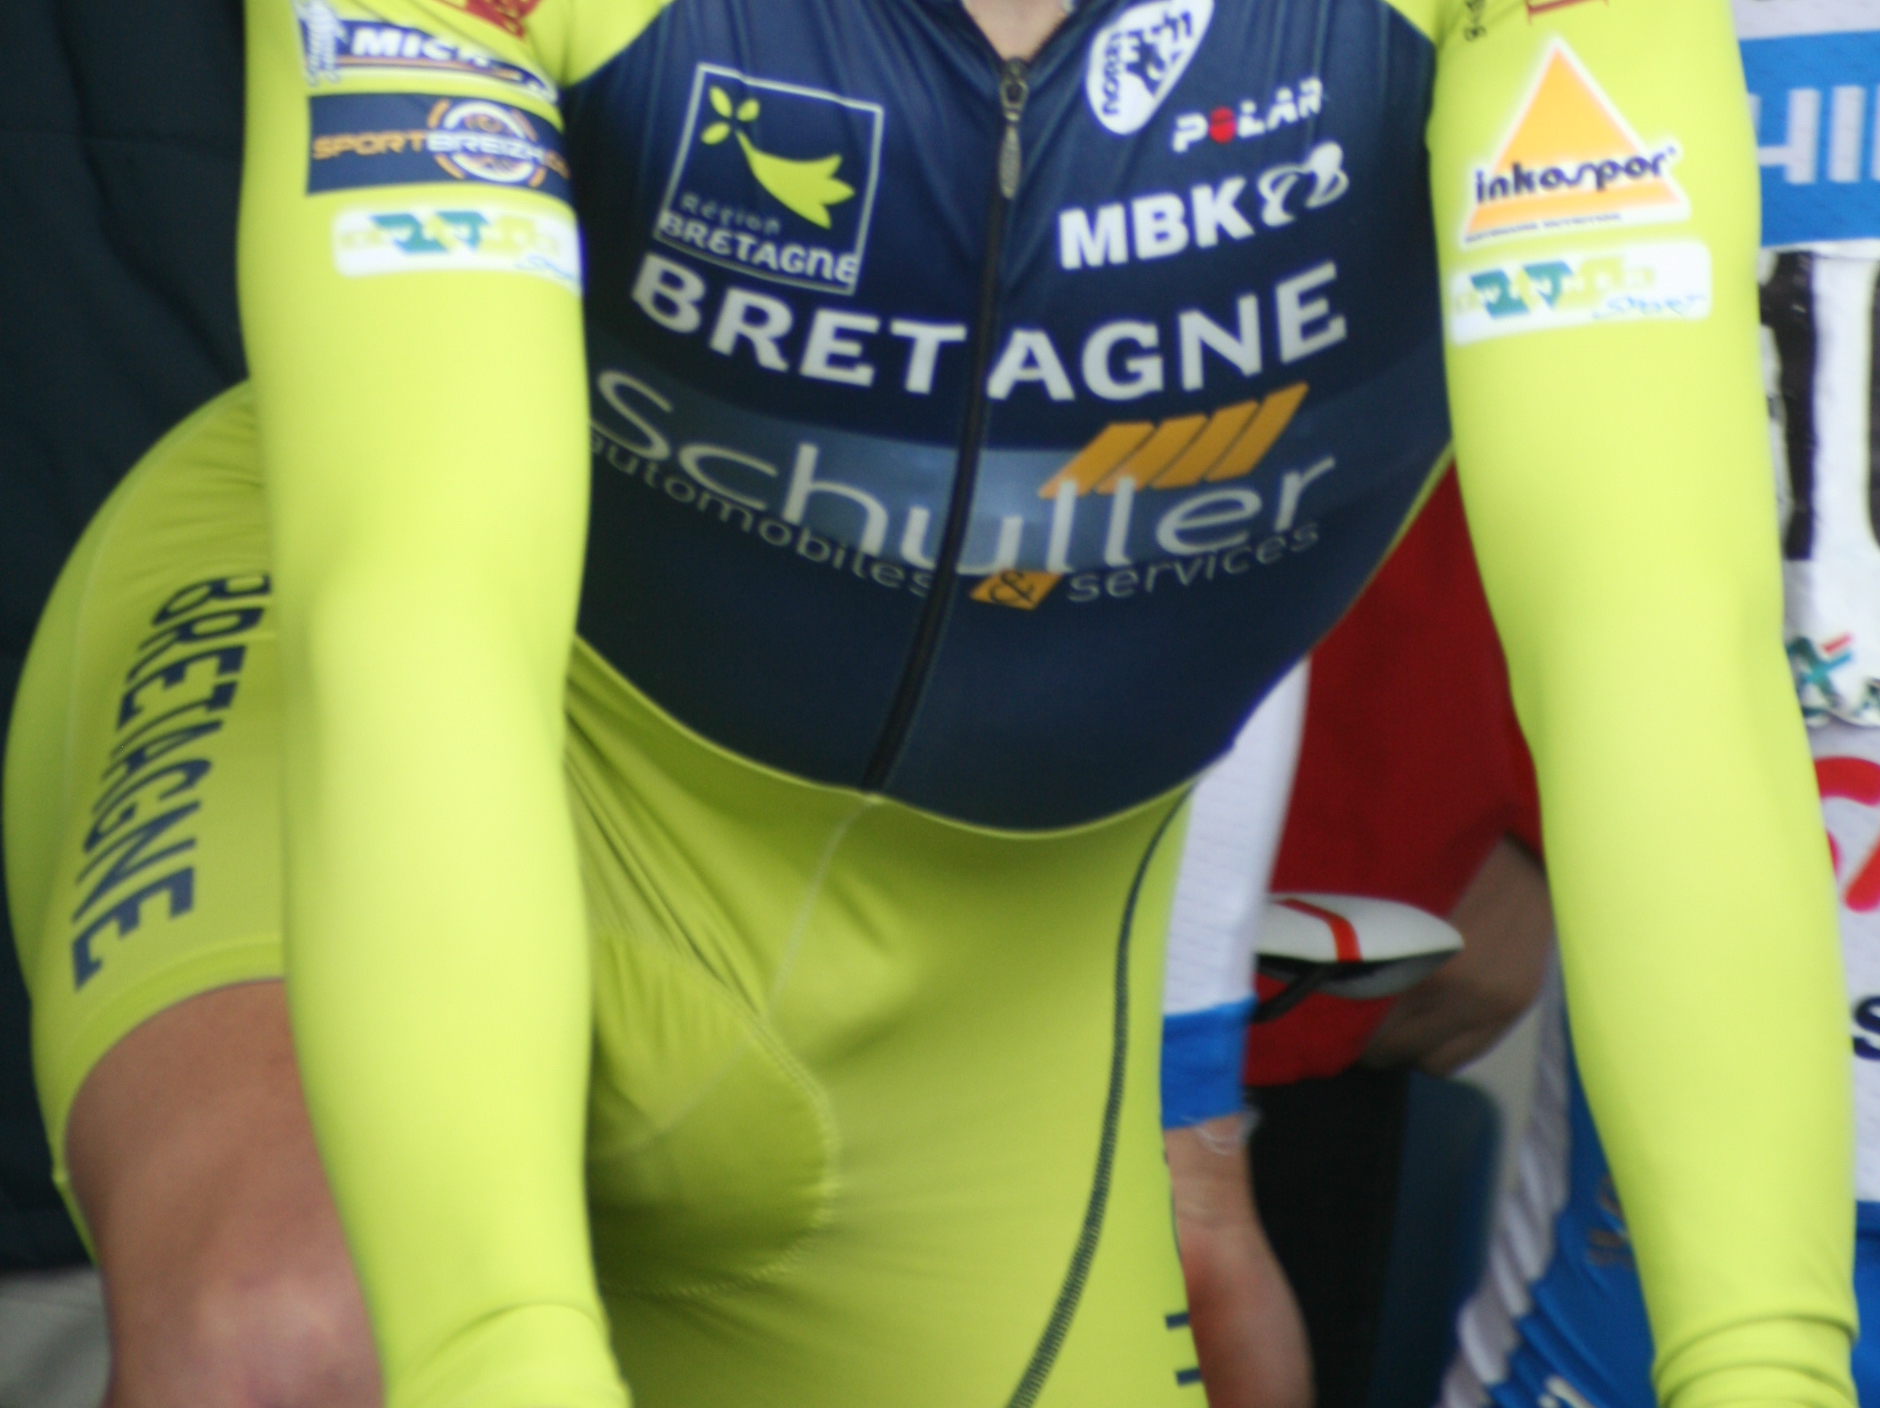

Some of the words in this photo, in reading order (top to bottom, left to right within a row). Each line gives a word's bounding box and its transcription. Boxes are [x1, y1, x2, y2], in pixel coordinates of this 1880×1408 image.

[1172, 76, 1324, 153] POLAR
[1746, 82, 1880, 184] HI
[657, 208, 859, 286] BRETAGNE
[1057, 176, 1256, 271] MBK
[631, 252, 1348, 403] BRETAGNE
[590, 370, 1336, 577] Schuller
[1066, 521, 1321, 604] services
[70, 572, 273, 992] BRETAGNE
